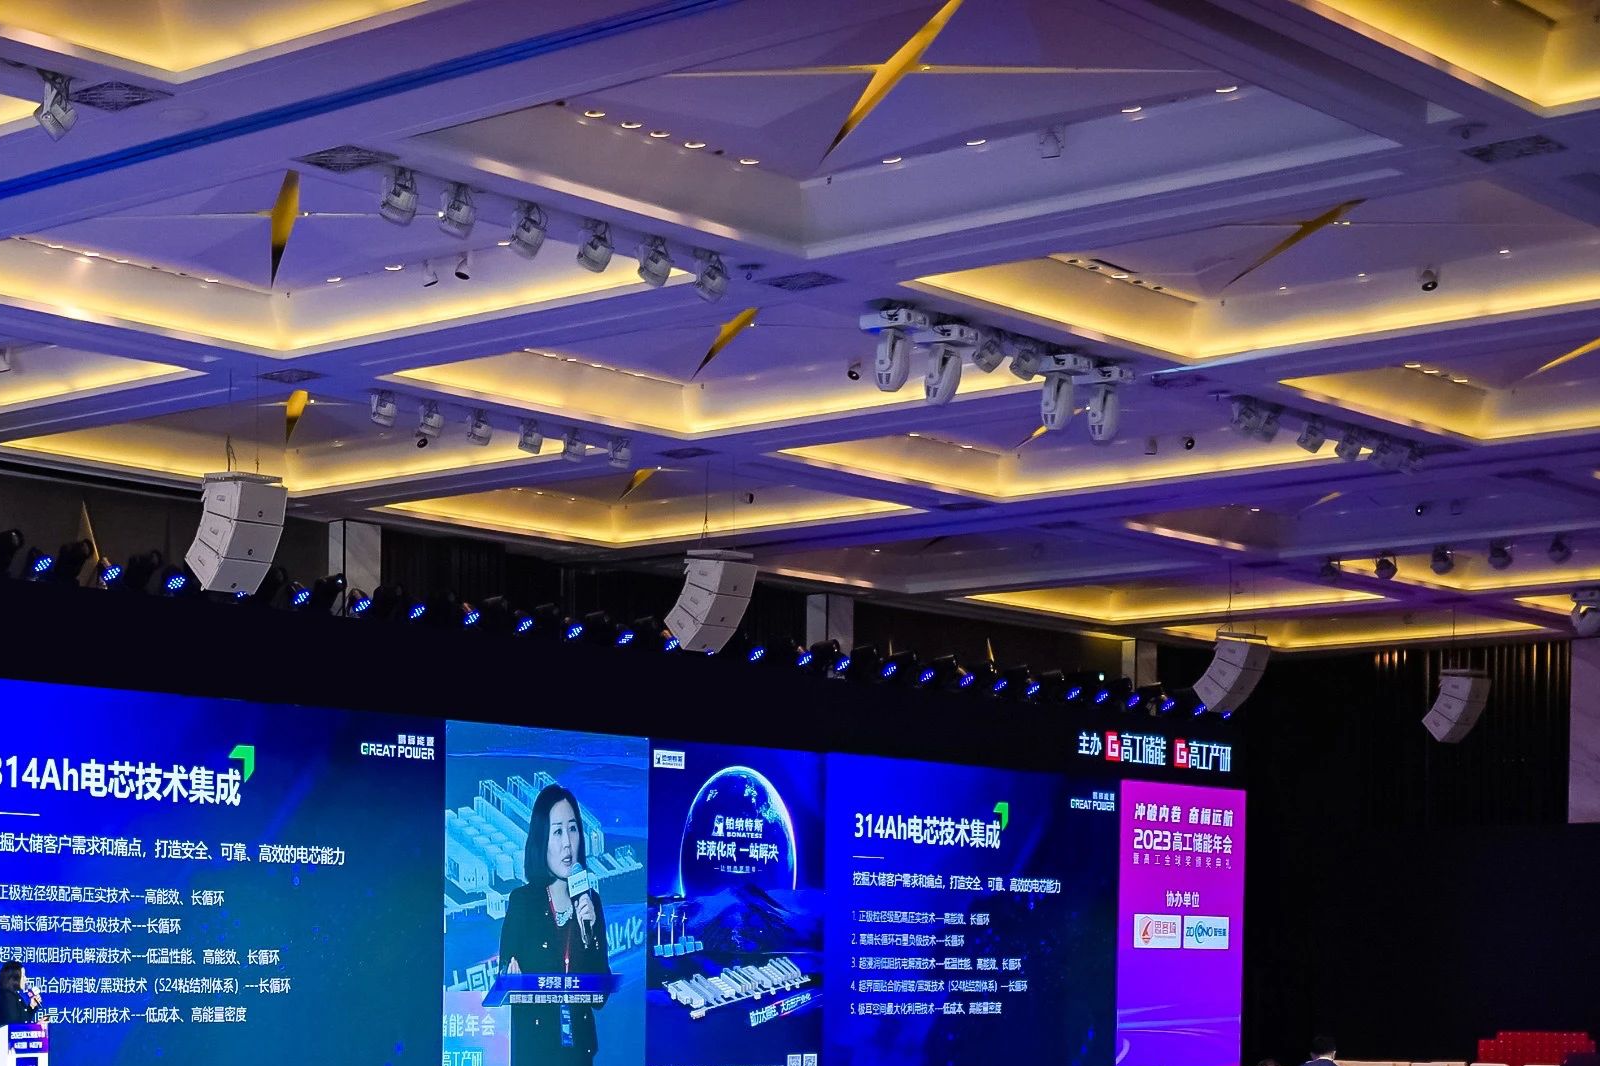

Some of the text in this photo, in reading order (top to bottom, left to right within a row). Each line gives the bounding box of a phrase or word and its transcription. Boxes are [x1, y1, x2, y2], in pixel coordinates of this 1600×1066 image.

[360, 742, 435, 761] GREAT POWER
[1078, 732, 1102, 756] 主办
[1120, 733, 1167, 766] 高工储能
[1188, 741, 1232, 772] 高工产研
[1070, 798, 1092, 810] GREAT
[1134, 803, 1182, 823] 冲破内卷
[725, 816, 764, 833] 铂纳特斯
[853, 813, 1001, 850] 314Ah电芯技术集成
[696, 840, 737, 862] 注液化成
[1133, 828, 1233, 855] 2023高工储能年会
[1166, 890, 1200, 908] 协办单位
